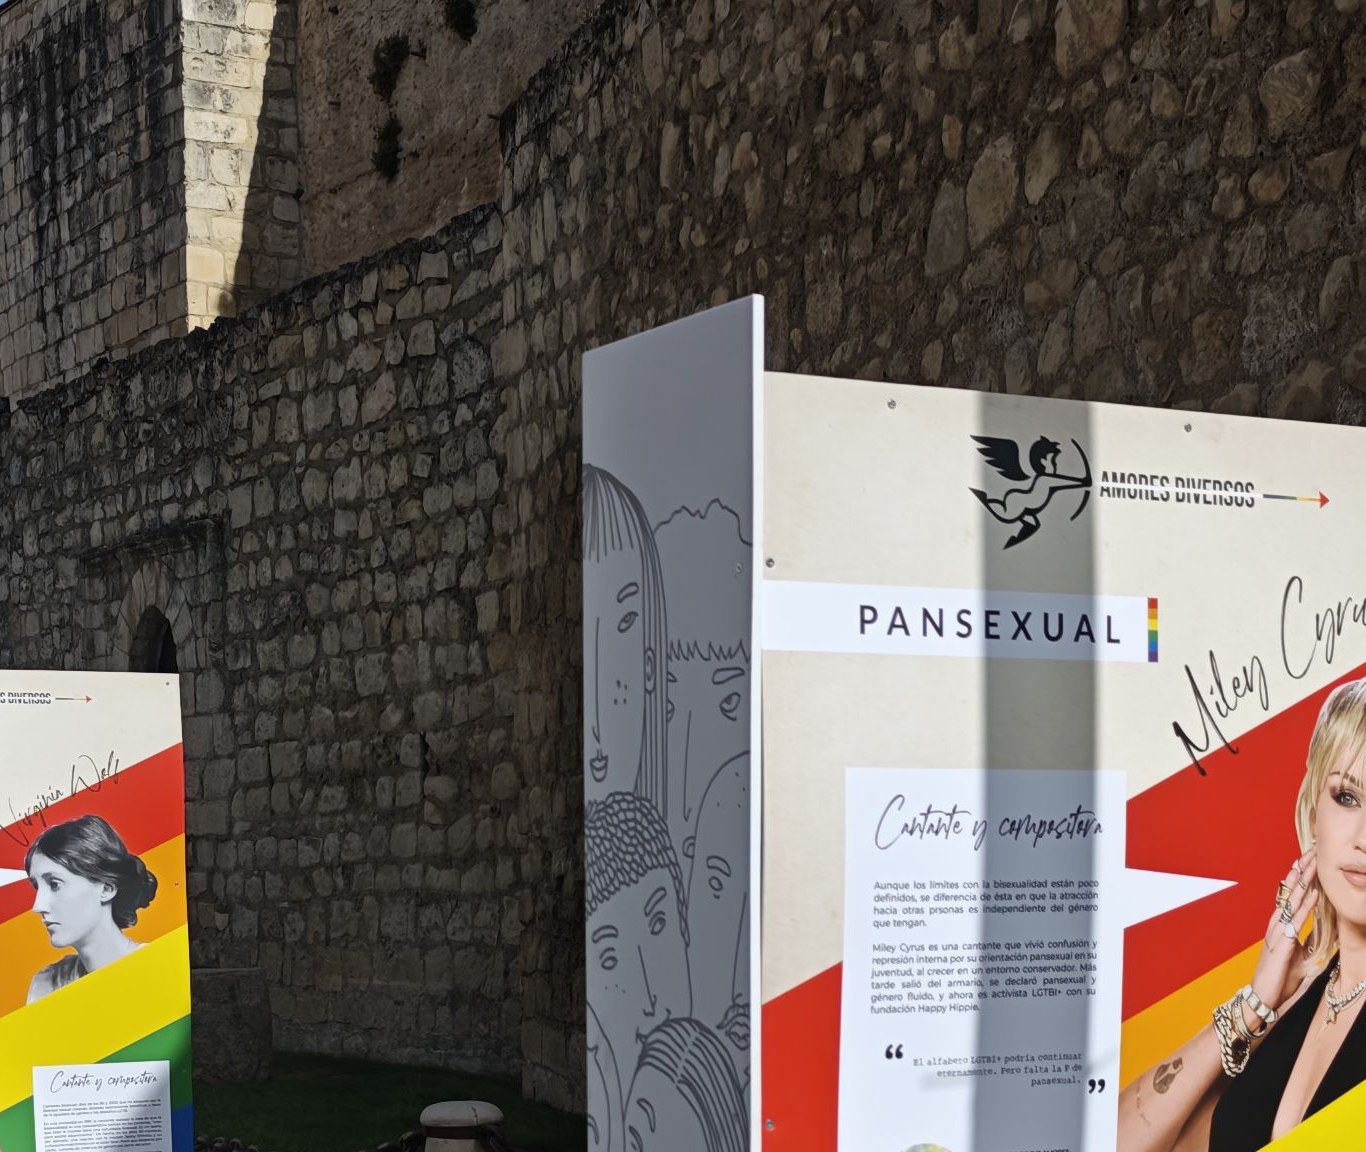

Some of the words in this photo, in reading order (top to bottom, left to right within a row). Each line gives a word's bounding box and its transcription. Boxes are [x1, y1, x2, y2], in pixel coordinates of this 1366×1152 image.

[1100, 471, 1170, 502] AMORES
[1175, 477, 1255, 508] DIVERSOS
[859, 605, 1120, 644] PANSEXUAL
[1172, 650, 1268, 776] Miley
[875, 794, 971, 850] Cantante
[972, 817, 987, 851] y
[999, 805, 1103, 848] compositora
[873, 880, 909, 891] Aunque
[913, 880, 926, 889] los
[929, 880, 959, 889] límites
[993, 879, 1047, 888] bisexualidad
[1050, 879, 1074, 887] están
[1077, 880, 1099, 889] poco
[873, 893, 917, 903] definidos,
[933, 892, 976, 901] diferencia
[993, 892, 1012, 901] ésta
[1029, 893, 1046, 902] que
[1059, 891, 1098, 900] atracción
[873, 905, 897, 915] hacia
[902, 905, 924, 914] otras
[982, 903, 1046, 915] independiente
[1050, 903, 1063, 912] del
[1067, 903, 1098, 914] género
[873, 920, 890, 929] que
[892, 918, 926, 929] tengan.
[872, 943, 896, 954] Miley
[899, 942, 925, 953] Cyrus
[942, 943, 958, 951] una
[961, 941, 1001, 950] cantante
[1004, 942, 1021, 951] que
[1024, 940, 1044, 949] vivió
[1047, 939, 1089, 949] confusión
[872, 955, 914, 966] represión
[916, 954, 948, 963] interna
[949, 955, 964, 964] por
[978, 952, 1027, 962] orientación
[1029, 952, 1072, 963] pansexual
[871, 967, 914, 978] juventud,
[985, 965, 1020, 974] entorno
[1022, 964, 1077, 973] conservador.
[1079, 963, 1096, 972] Más
[871, 980, 895, 989] tarde
[901, 979, 922, 988] salió
[927, 979, 941, 987] del
[1005, 976, 1037, 986] declaró
[1042, 975, 1086, 987] pansexual
[870, 992, 903, 1003] género
[907, 991, 934, 1001] fluido,
[948, 990, 973, 999] ahora
[991, 989, 1027, 998] activista
[870, 1004, 915, 1014] fundación
[918, 1003, 947, 1014] Happy
[50, 1070, 94, 1093] Cantante
[107, 1070, 157, 1088] compositora
